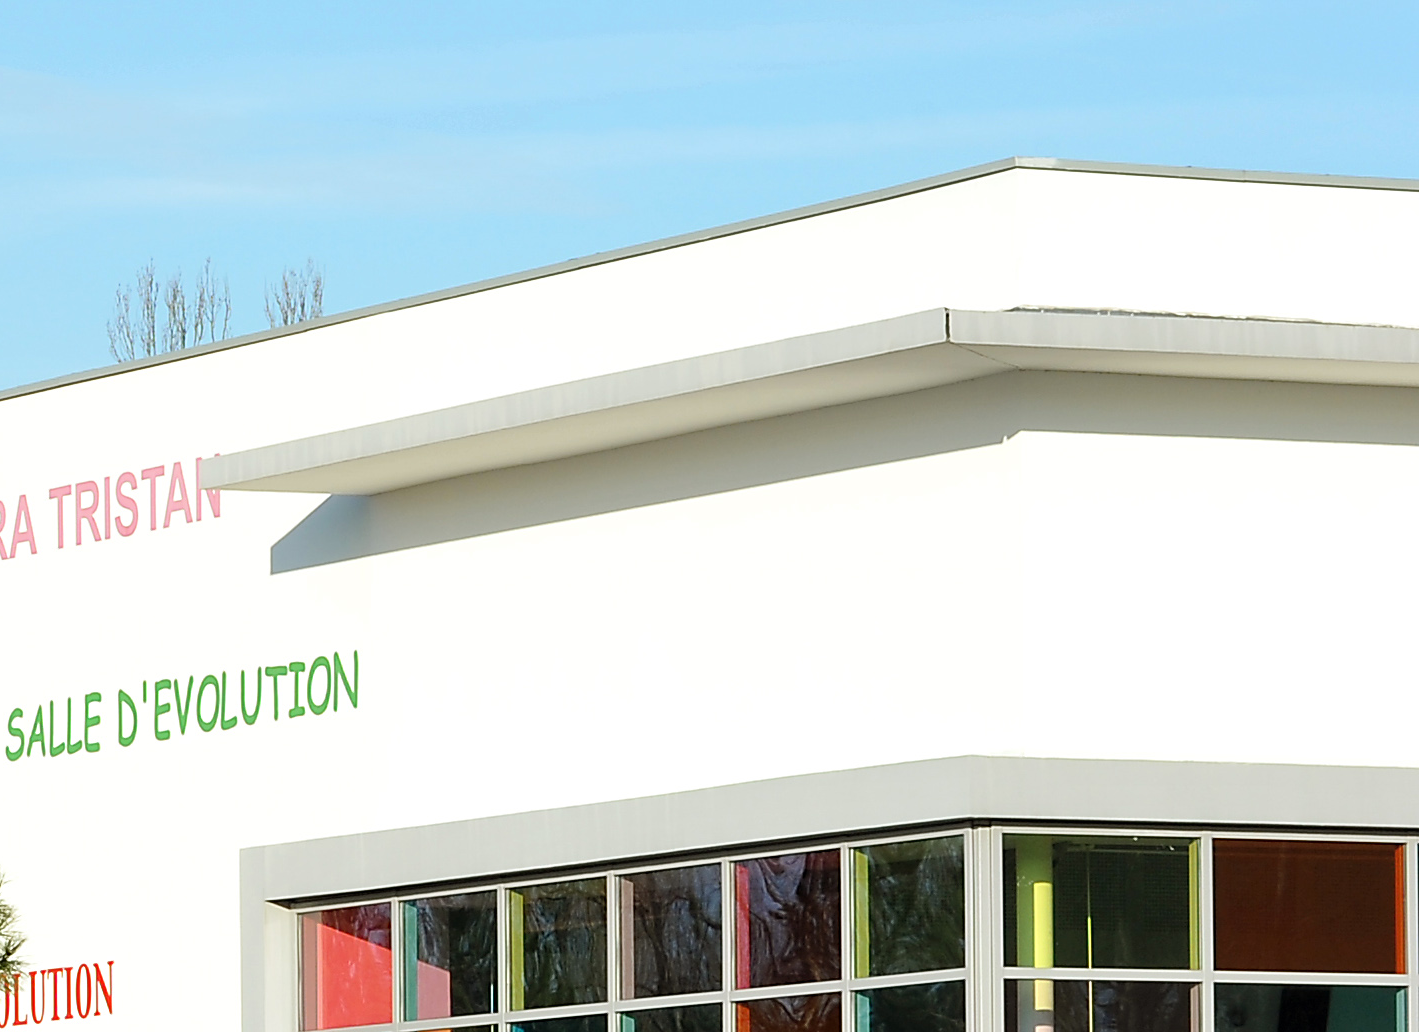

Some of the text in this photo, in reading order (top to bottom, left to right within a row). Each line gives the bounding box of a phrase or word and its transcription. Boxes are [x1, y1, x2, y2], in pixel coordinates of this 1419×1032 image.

[48, 453, 221, 549] TRISTAN
[5, 649, 360, 762] SALLE D'EVOLUTION
